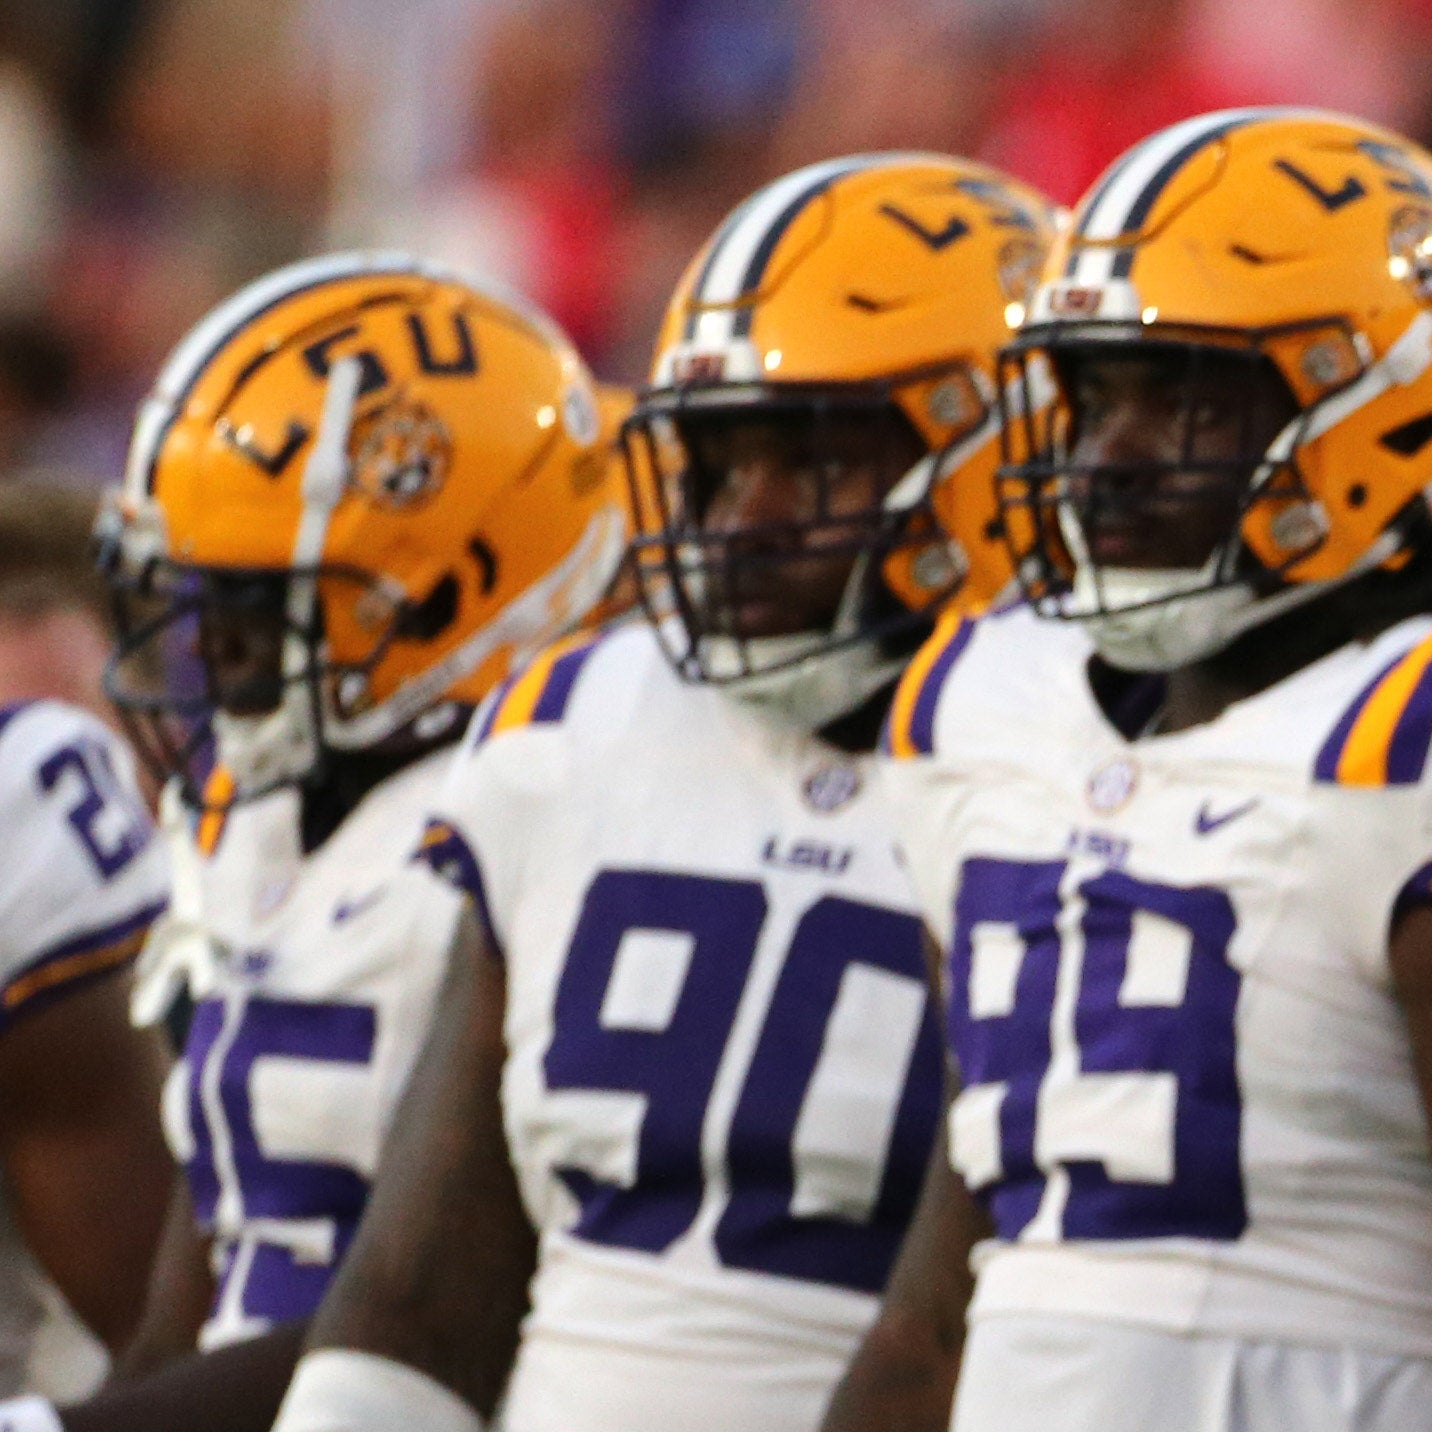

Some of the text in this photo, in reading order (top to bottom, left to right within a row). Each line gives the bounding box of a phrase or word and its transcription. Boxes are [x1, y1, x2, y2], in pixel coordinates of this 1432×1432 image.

[762, 836, 853, 874] LSU
[543, 867, 945, 1294] 90
[947, 857, 1249, 1243] 99
